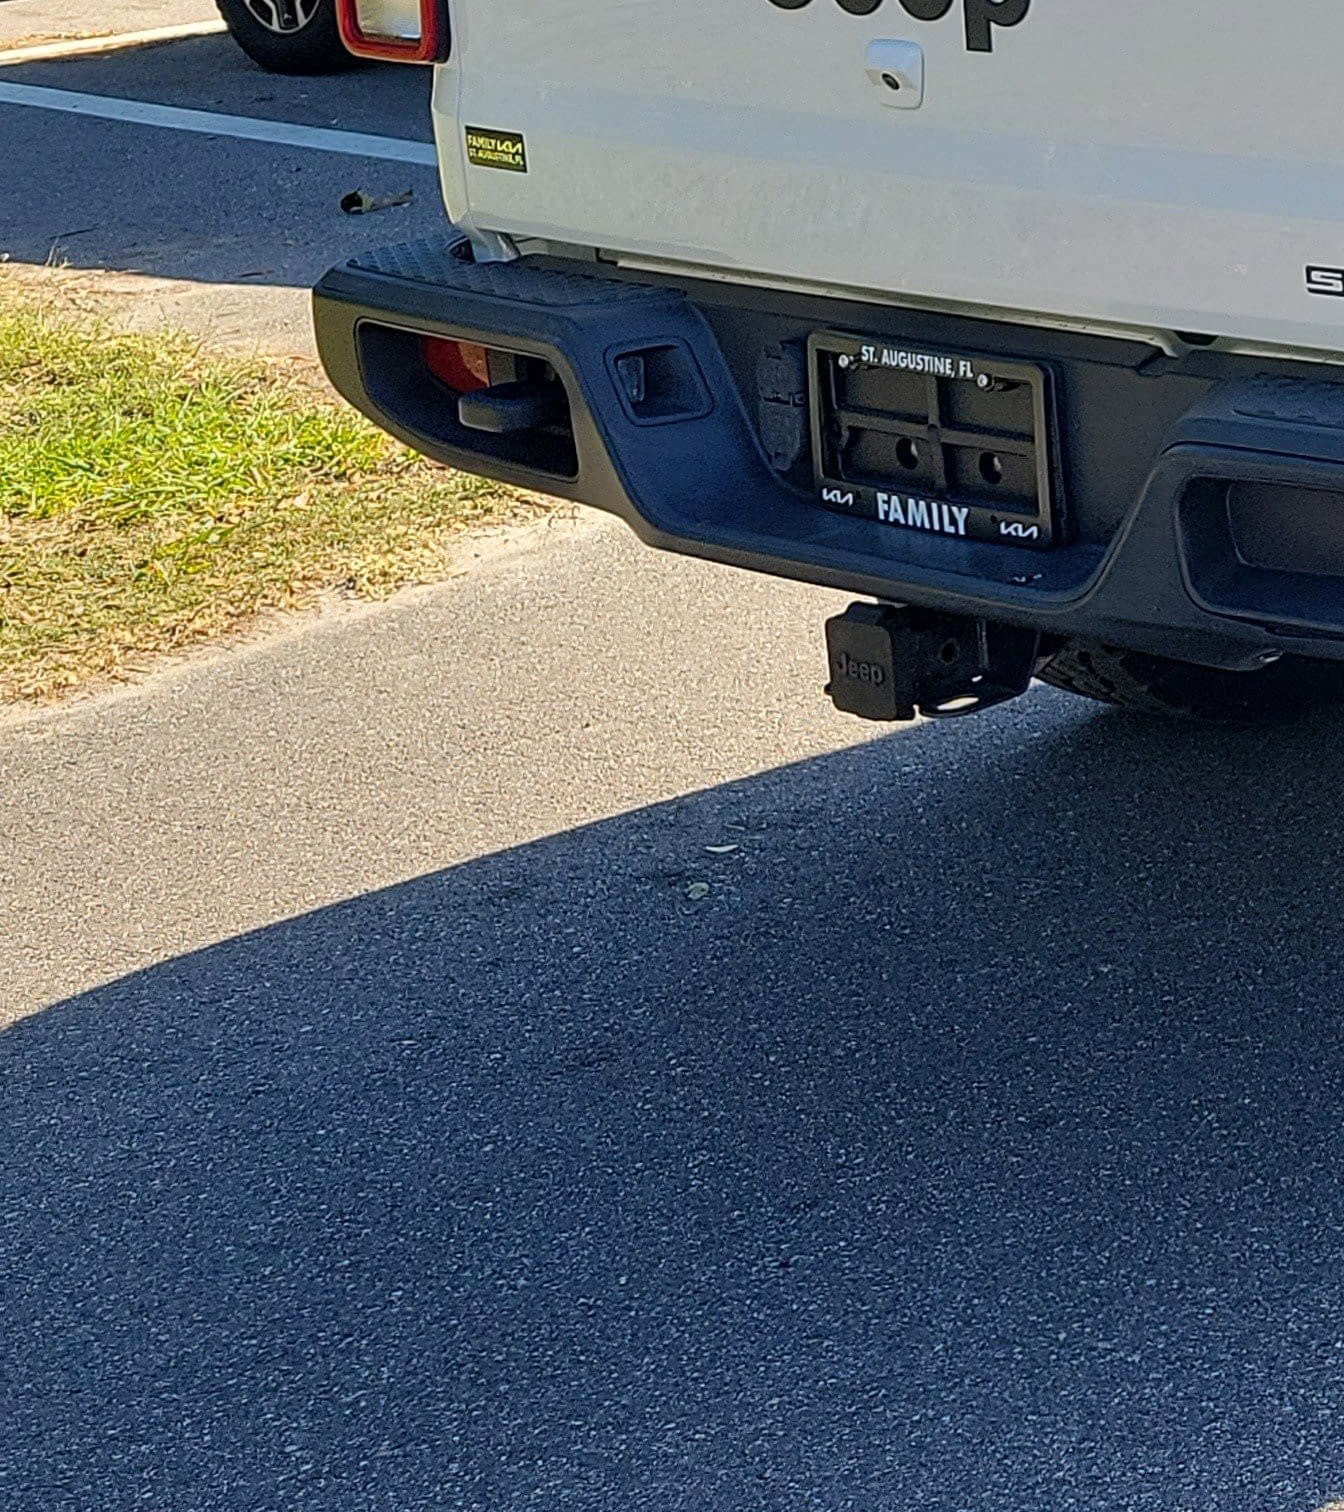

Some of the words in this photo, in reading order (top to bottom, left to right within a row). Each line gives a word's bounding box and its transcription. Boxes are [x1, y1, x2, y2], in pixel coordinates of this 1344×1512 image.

[861, 345, 878, 363] ST.
[881, 348, 956, 378] AUGUSTINE,
[959, 360, 974, 378] FL
[822, 487, 853, 506] KIA
[876, 492, 970, 536] FAMILY
[1000, 521, 1039, 539] KIA
[833, 652, 884, 687] Jeep
